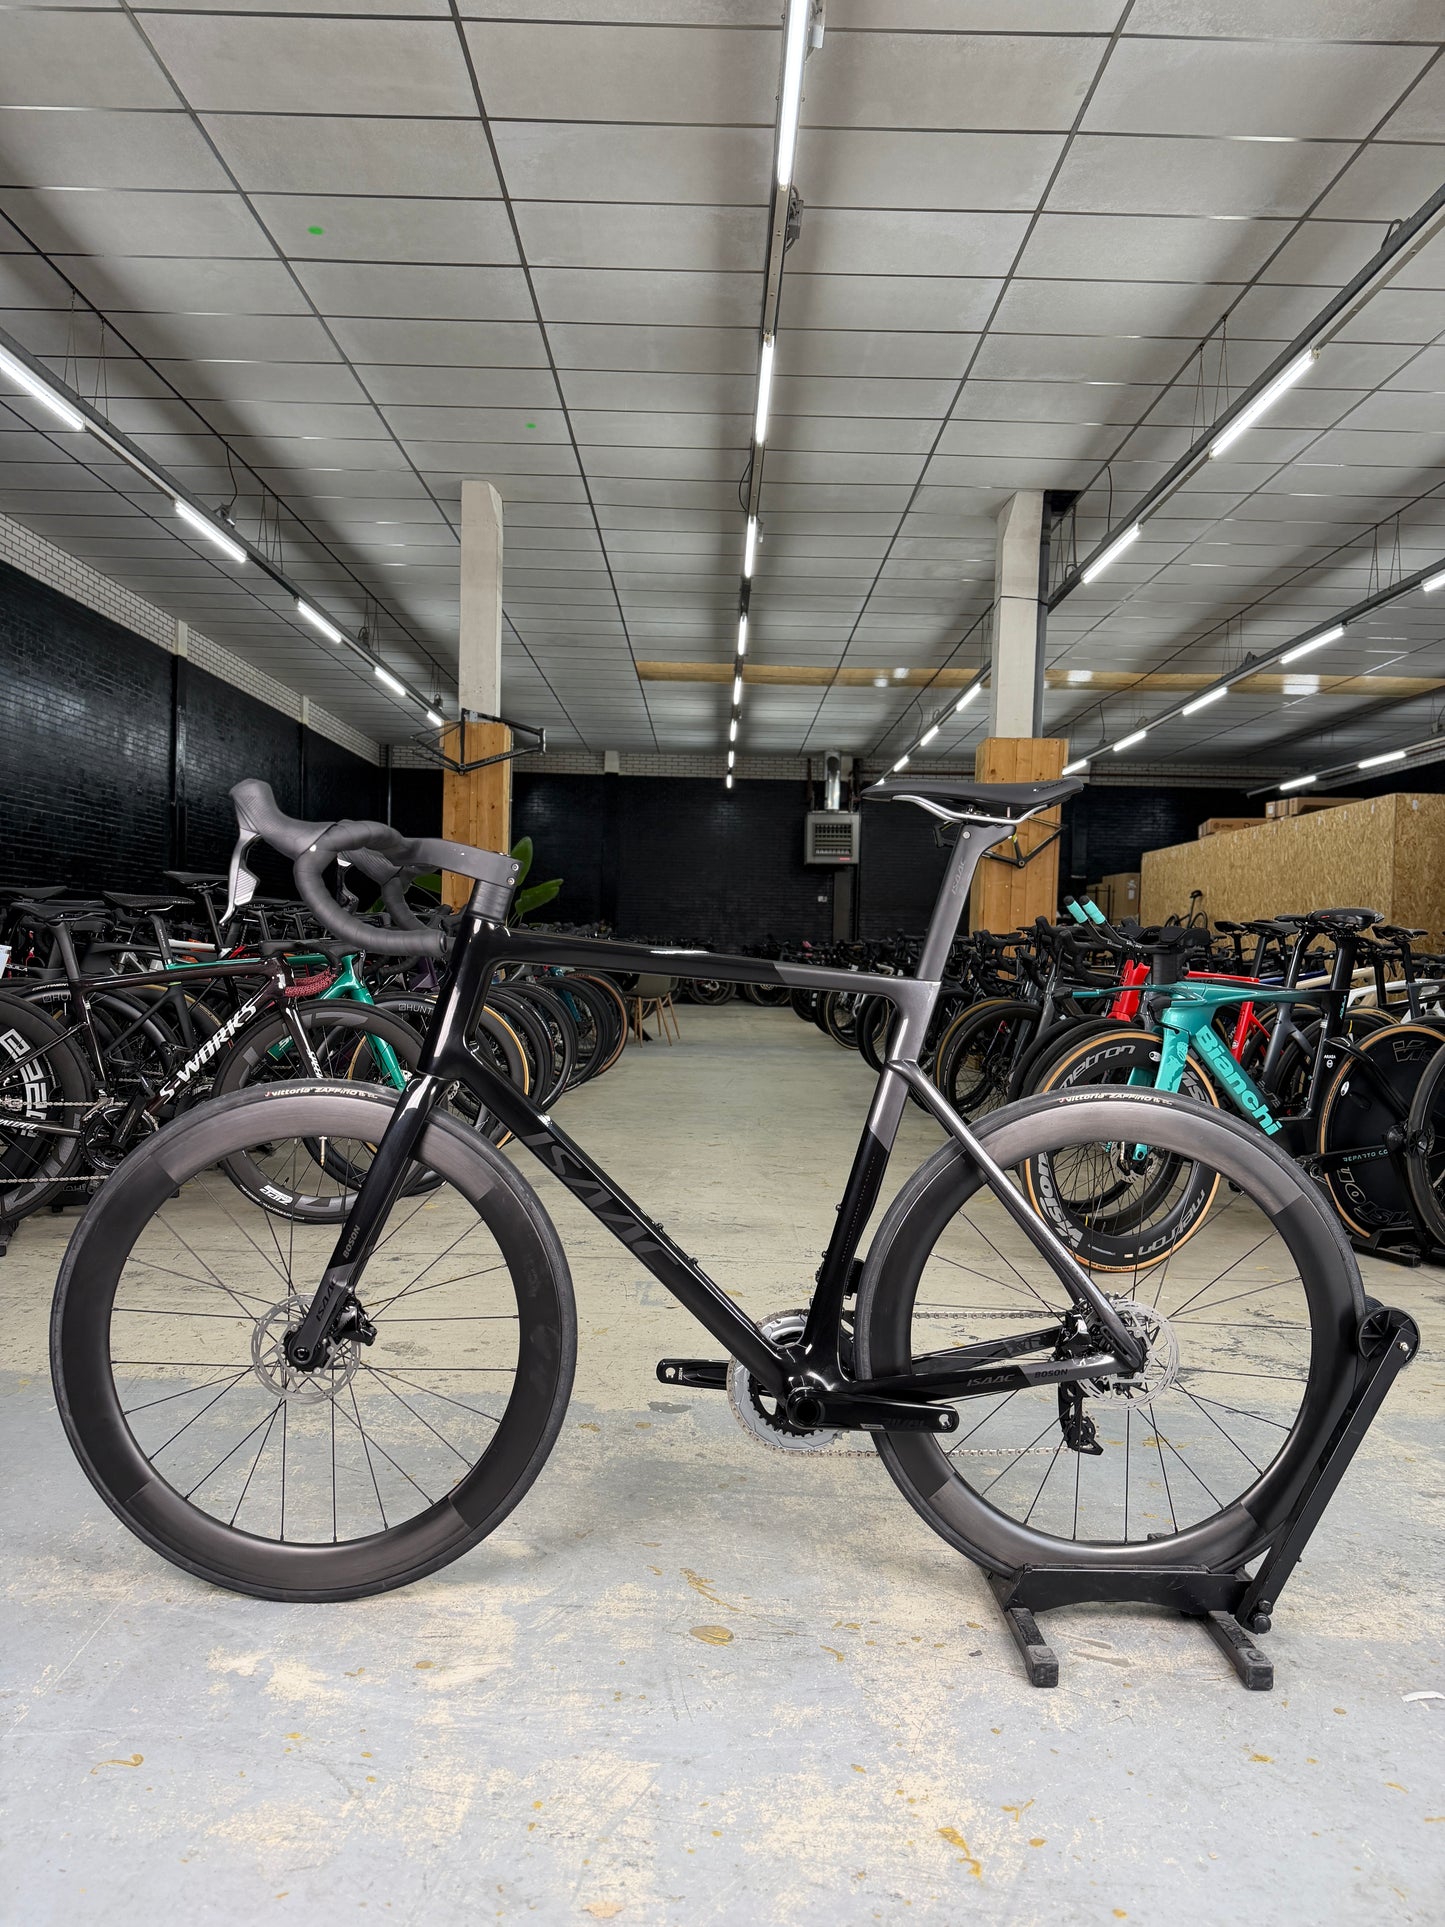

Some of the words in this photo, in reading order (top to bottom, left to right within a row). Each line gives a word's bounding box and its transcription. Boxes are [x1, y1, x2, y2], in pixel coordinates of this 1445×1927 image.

[406, 1003, 434, 1015] HUNT
[159, 997, 257, 1105] S-WORKS
[1195, 1024, 1283, 1136] Bianchi
[525, 1131, 680, 1266] ISAAC
[342, 1225, 361, 1259] BOSON
[966, 1372, 1017, 1388] ISAAC
[1033, 1368, 1069, 1379] BOSON
